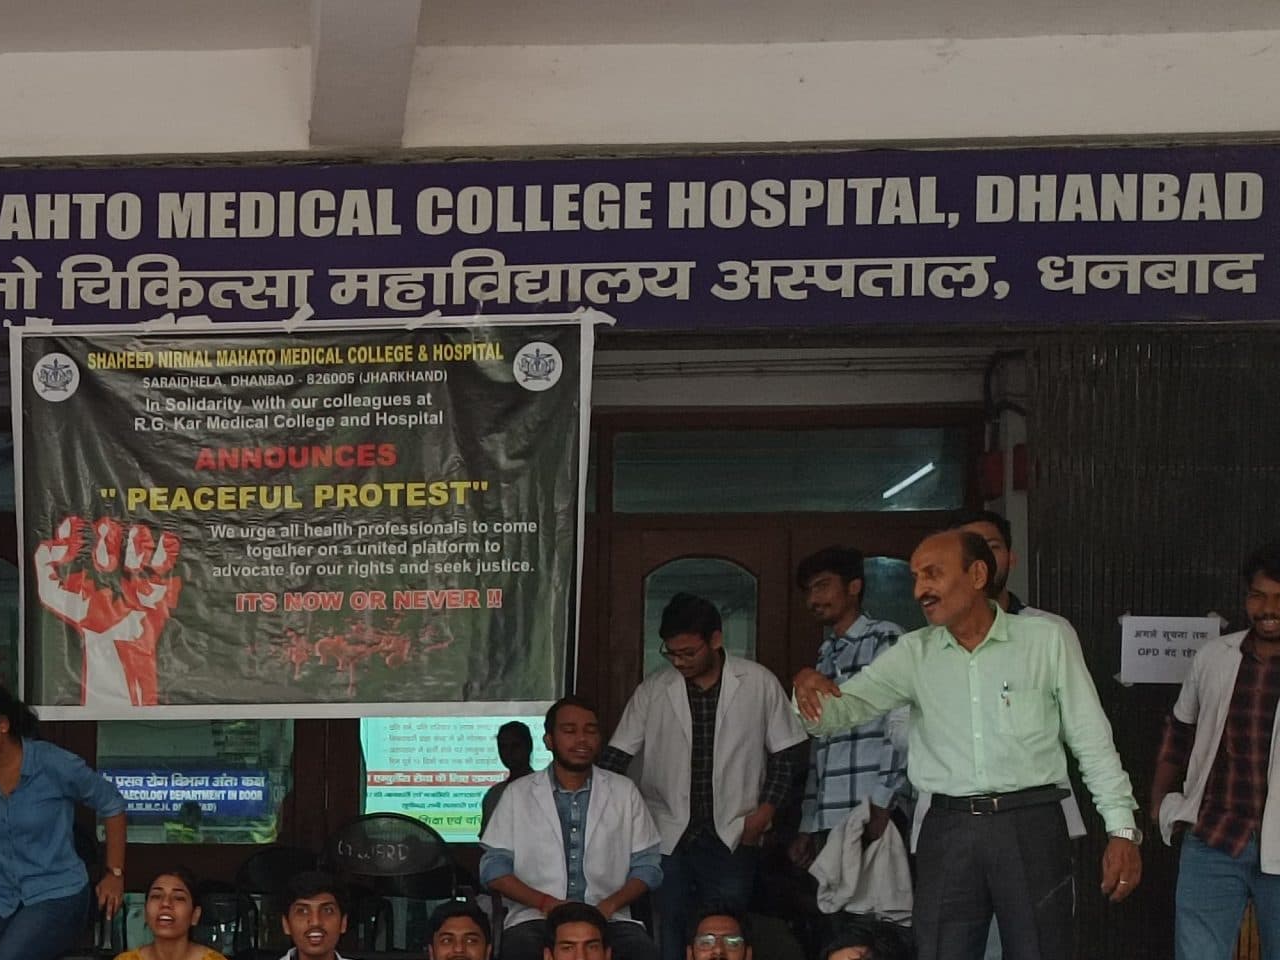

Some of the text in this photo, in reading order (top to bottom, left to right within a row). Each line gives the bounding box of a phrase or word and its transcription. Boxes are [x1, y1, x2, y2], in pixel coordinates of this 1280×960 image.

[158, 188, 402, 239] MEDICAL
[416, 182, 652, 236] COLLEGE
[668, 176, 960, 230] HOSPITAL,
[976, 171, 1264, 224] DHANBAD
[57, 253, 314, 311] चिकित्सा
[328, 248, 696, 311] महाविद्यालय
[710, 255, 1010, 302] अस्पताल,
[1037, 253, 1264, 296] धनबाद
[87, 342, 504, 369] SHAHEED NIRMAL MAHATO MEDICAL COLLEGE & HOSPITAL
[231, 373, 294, 387] DHANBAD
[306, 371, 355, 385] 826005
[359, 369, 448, 385] (JHARKHAND)
[146, 393, 433, 413] In Solidarity with our colleagues at
[134, 410, 443, 432] R.G. Kar Medical College and Hospital
[195, 443, 398, 470] ANNOUNCES
[127, 485, 302, 512] PEACEFUL
[314, 481, 489, 509] PROTEST"
[210, 520, 538, 542] We urge all health professionals to come
[246, 540, 501, 560] together on a united platform to
[212, 558, 535, 578] advocate for our rights and seek justice.
[235, 592, 278, 613] ITS
[283, 590, 344, 612] NOW
[349, 590, 388, 611] OR
[393, 588, 481, 610] NEVER
[1137, 647, 1160, 657] OPD
